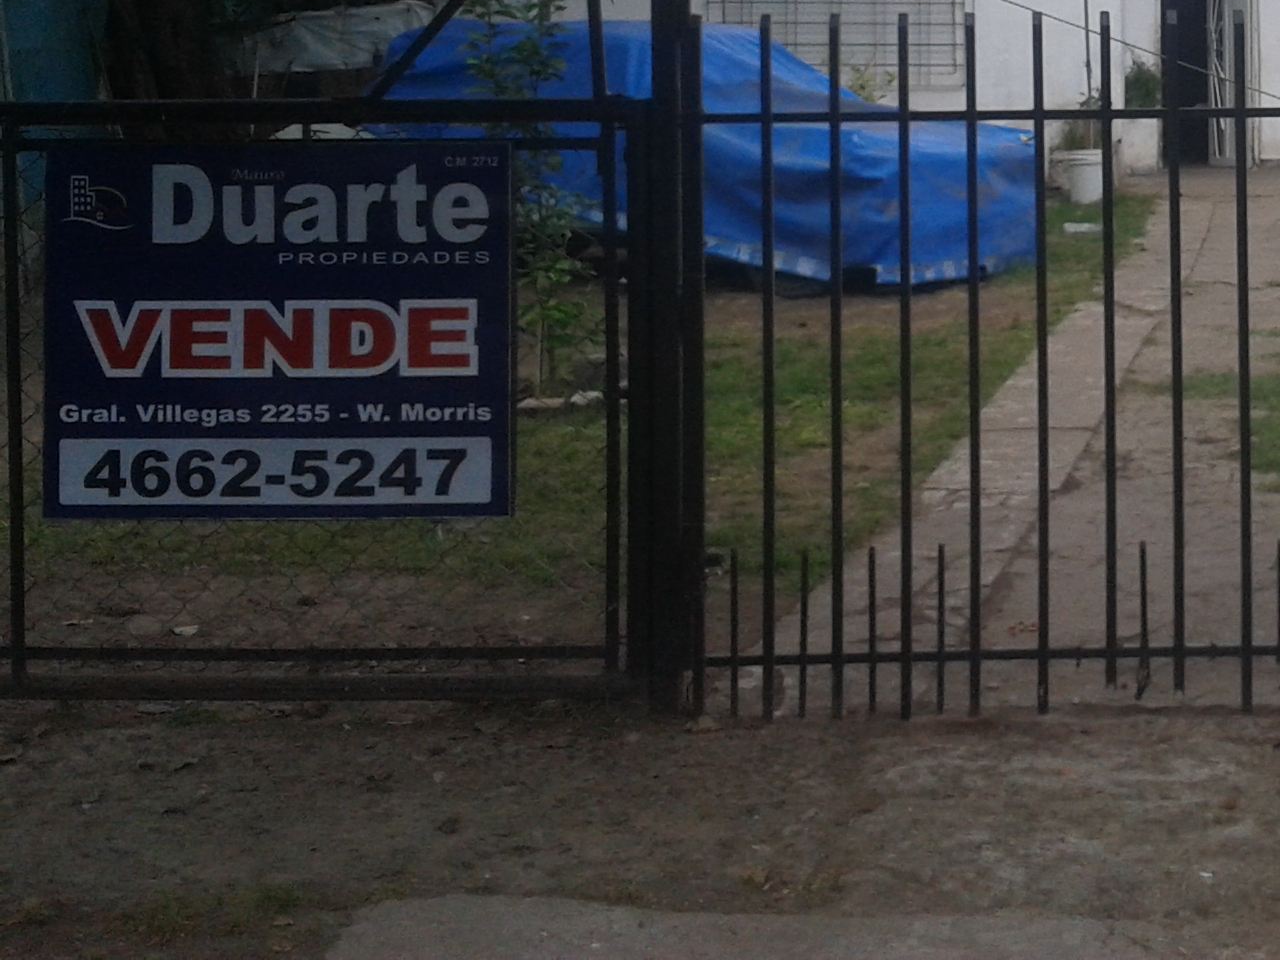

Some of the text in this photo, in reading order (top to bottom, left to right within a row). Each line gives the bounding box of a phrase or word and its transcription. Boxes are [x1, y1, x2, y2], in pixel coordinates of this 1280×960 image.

[151, 163, 490, 244] Duarte
[278, 250, 491, 266] PROPIEDADES
[73, 298, 480, 378] VENDE
[58, 404, 126, 424] Gral.
[136, 403, 252, 428] Villegas
[260, 404, 330, 424] 2255
[357, 403, 391, 424] W.
[400, 402, 492, 423] Morris
[83, 447, 468, 499] 4662-5247
